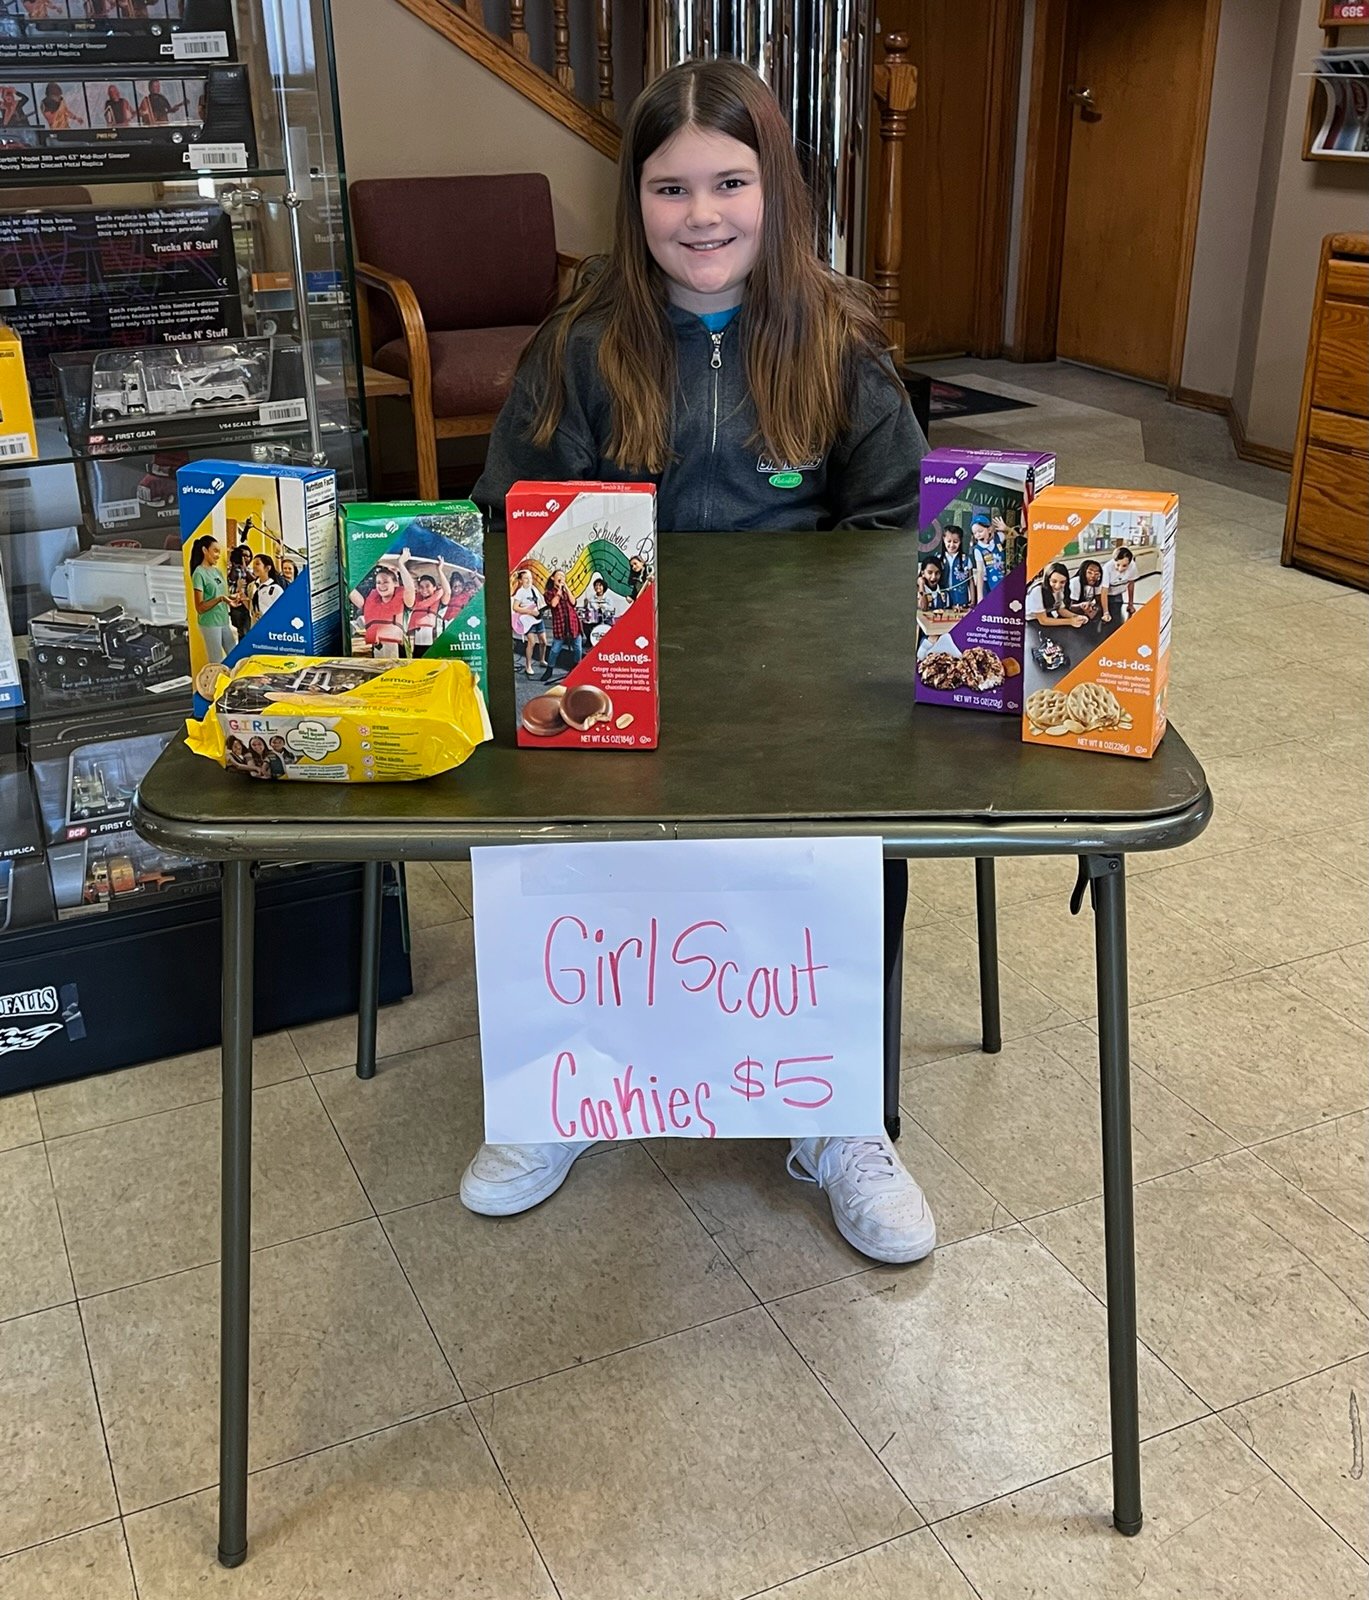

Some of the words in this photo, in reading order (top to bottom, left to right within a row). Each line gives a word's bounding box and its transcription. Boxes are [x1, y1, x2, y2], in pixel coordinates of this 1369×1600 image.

[151, 243, 181, 253] Trucks
[196, 239, 219, 250] Stuff
[163, 333, 192, 342] Trucks
[206, 328, 228, 338] Stuff
[115, 432, 135, 440] FIRST
[136, 430, 156, 438] GEAR
[924, 475, 936, 484] girl
[936, 477, 957, 485] scouts
[182, 485, 194, 494] girl
[194, 486, 215, 495] scouts
[512, 510, 525, 519] girl
[526, 510, 548, 518] scouts
[1033, 522, 1046, 531] girl
[1046, 524, 1070, 532] scouts
[352, 532, 365, 541] girl
[458, 632, 480, 641] thin
[953, 694, 963, 702] NET
[964, 695, 972, 703] WT
[580, 735, 591, 743] NET
[592, 735, 601, 743] WT
[1089, 739, 1098, 747] WT
[68, 828, 86, 838] DCP
[100, 821, 124, 832] FIRST
[4, 846, 35, 856] REPLICA
[544, 914, 658, 1008] Girl
[671, 919, 829, 1019] Scout
[3, 988, 55, 1014] FALLS
[551, 1051, 717, 1140] Cookies
[729, 1053, 834, 1110] $5
